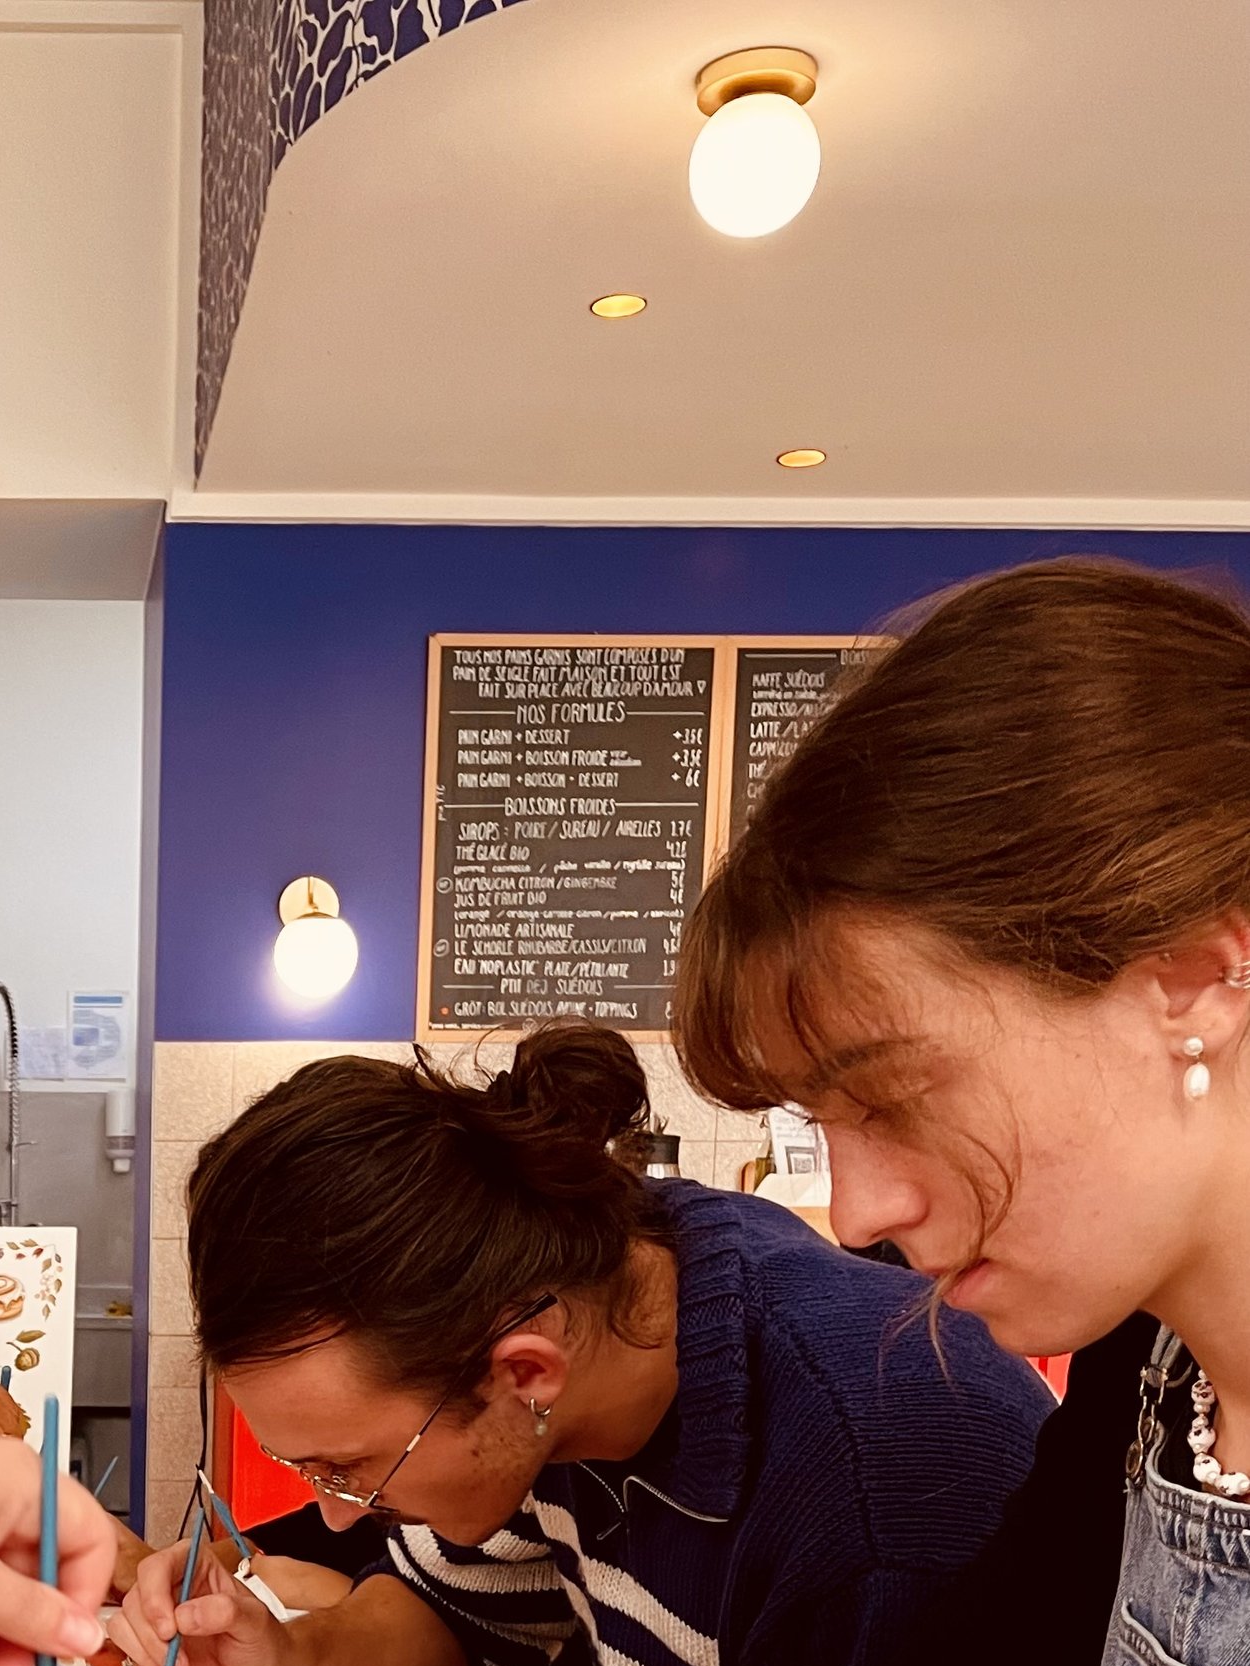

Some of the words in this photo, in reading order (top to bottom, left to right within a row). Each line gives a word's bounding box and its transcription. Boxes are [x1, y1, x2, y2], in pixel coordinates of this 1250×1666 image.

[453, 649, 482, 665] TOUS
[483, 649, 502, 665] NOS
[505, 649, 532, 665] PAINS
[534, 649, 571, 665] GARNIS
[575, 648, 603, 665] SONT
[453, 665, 476, 681] PAIN
[478, 666, 492, 681] DE
[494, 665, 530, 682] SEIGLE
[533, 666, 557, 682] FAIT
[558, 666, 608, 681] MAISON
[610, 666, 625, 681] ET
[629, 665, 659, 681] TOUT
[661, 664, 682, 681] EST
[478, 682, 501, 698] FAIT
[504, 682, 526, 699] SUR
[527, 682, 558, 699] PLACE
[560, 679, 590, 698] AVEC
[591, 681, 642, 698] BEAUCOUP
[516, 703, 546, 725] NOS
[551, 701, 626, 724] FORMULES
[458, 729, 479, 745] PAIN
[481, 729, 512, 745] GARNI
[525, 729, 571, 745] DESSERT
[750, 721, 781, 738] LATTE
[457, 750, 479, 766] PAIN
[481, 750, 512, 766] GARNI
[525, 750, 569, 766] BOISSON
[572, 750, 608, 766] FROIDE
[457, 773, 478, 788] PAIN
[479, 773, 510, 788] GARNI
[524, 773, 566, 788] BOISSON
[578, 772, 619, 788] DESSERT
[505, 797, 567, 816] BOISSONS
[570, 797, 616, 816] FROIDES
[458, 821, 500, 841] SIROPS
[514, 821, 547, 839] POIRE
[559, 820, 600, 839] SUREAU
[615, 820, 661, 837] AIRELLES
[456, 842, 476, 860] THÉ
[477, 842, 508, 860] GLACÉ
[510, 845, 530, 861] BIO
[454, 877, 516, 892] KOMBUCHA
[454, 893, 475, 908] JUS
[477, 892, 491, 906] DE
[494, 891, 525, 906] FRUIT
[527, 891, 547, 905] BIO
[454, 923, 511, 938] LIMONADE
[515, 923, 575, 938] ARTISANALE
[454, 940, 467, 955] LE
[454, 958, 476, 975] EAU
[555, 976, 603, 996] SUÉDOIS
[487, 1001, 506, 1016] BOL
[508, 997, 554, 1016] SUÉDOIS
[595, 1001, 638, 1019] TOPPINGS
